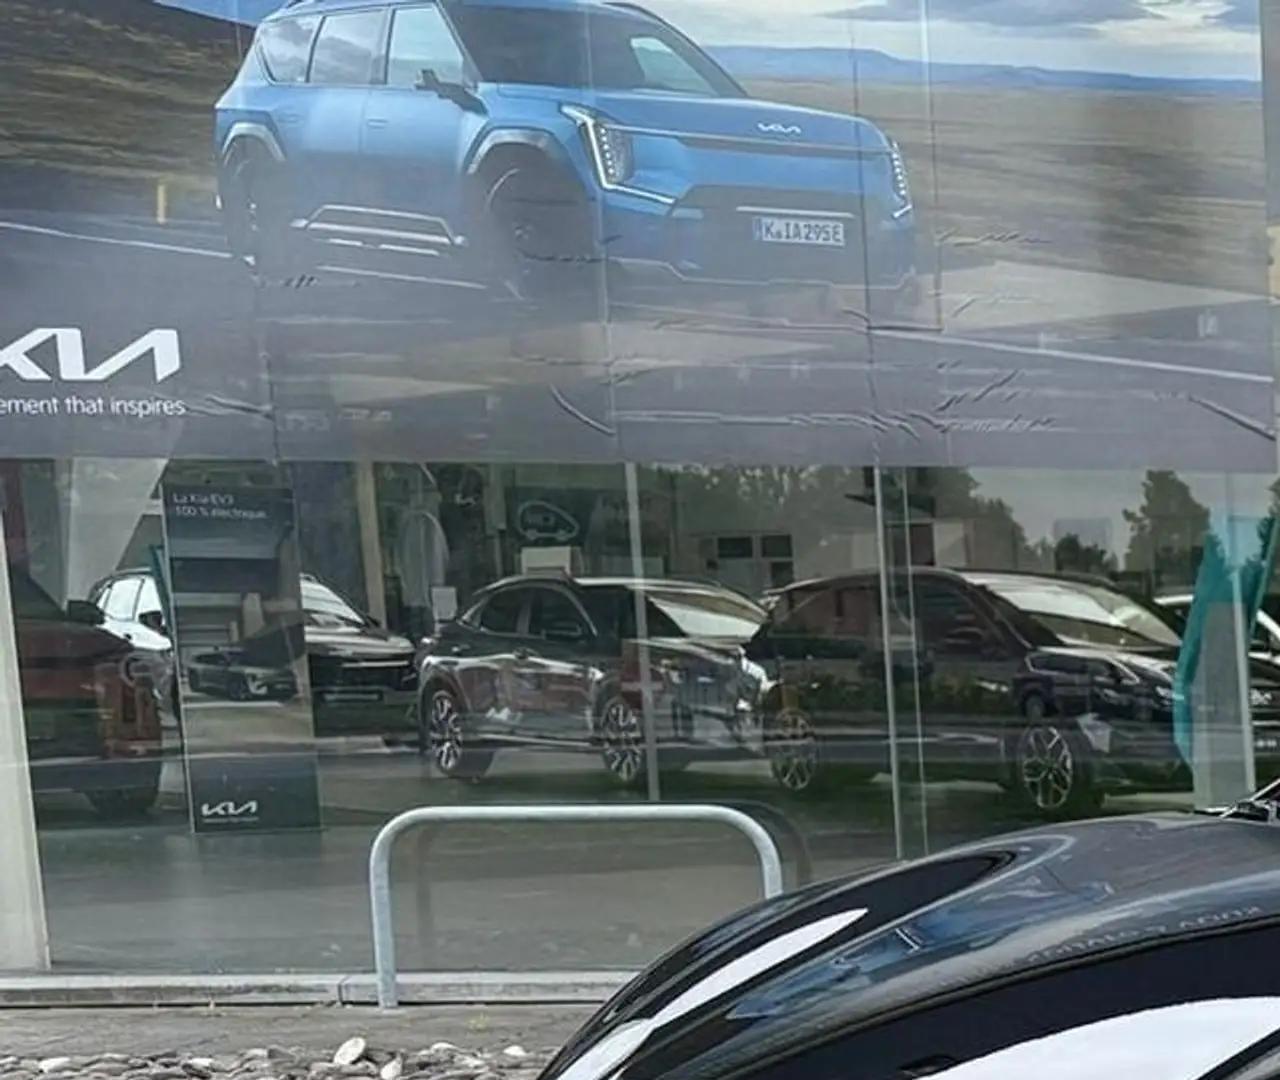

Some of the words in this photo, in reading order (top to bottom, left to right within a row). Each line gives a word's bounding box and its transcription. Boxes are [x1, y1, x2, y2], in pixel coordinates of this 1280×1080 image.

[63, 396, 104, 415] that
[110, 396, 187, 419] inspires
[201, 800, 258, 817] KIA
